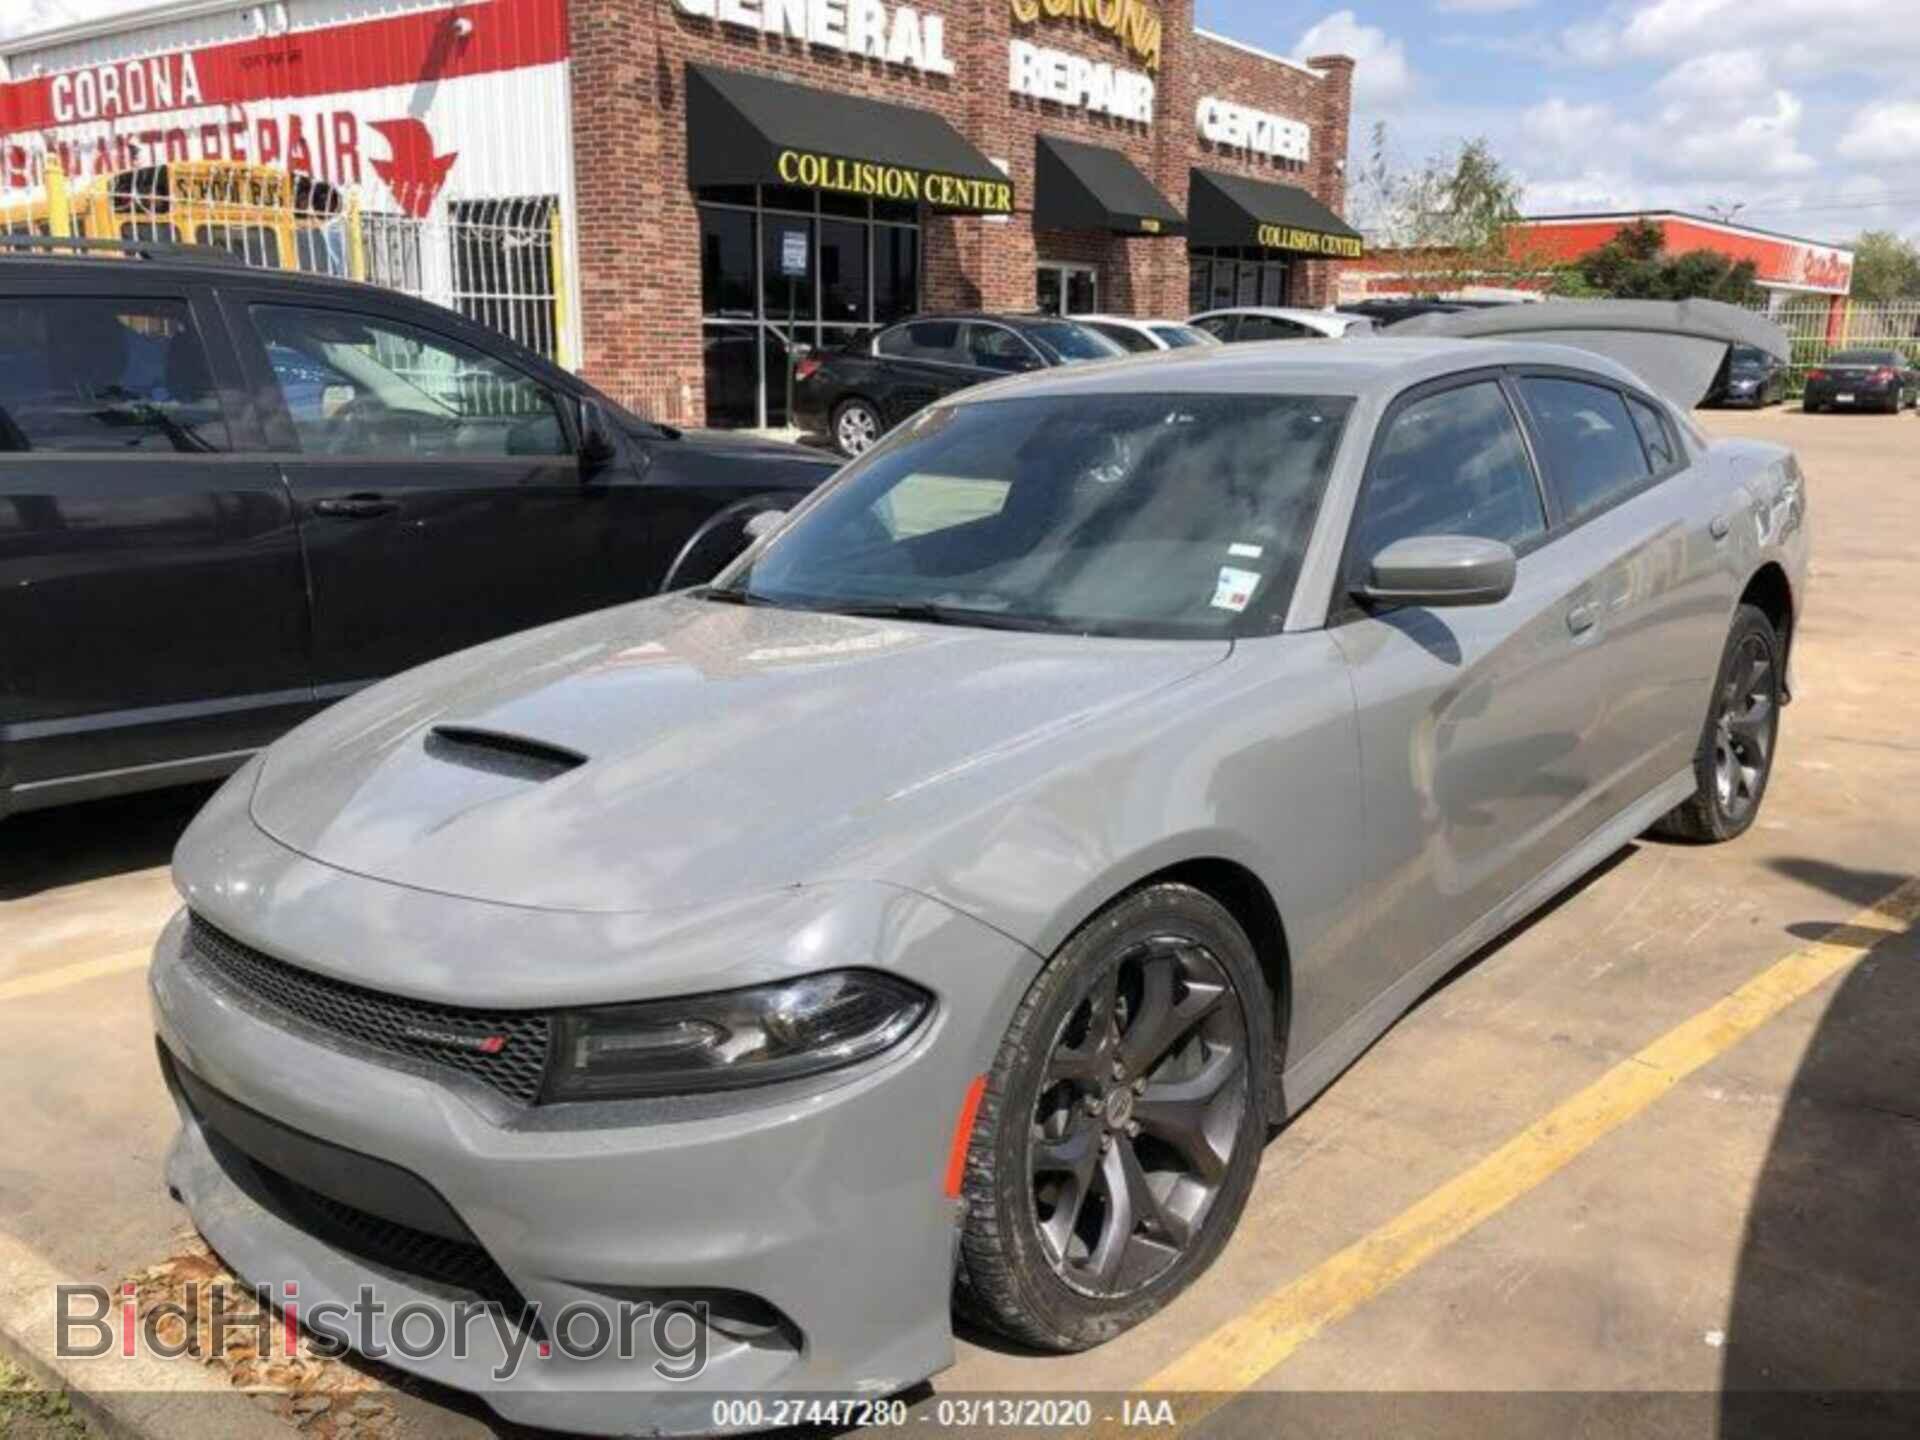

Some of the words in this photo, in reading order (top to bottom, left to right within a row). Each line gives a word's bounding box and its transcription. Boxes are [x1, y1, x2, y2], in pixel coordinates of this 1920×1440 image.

[50, 53, 203, 123] CORONA
[1008, 38, 1155, 124] REPAIR
[1195, 96, 1311, 163] CENTER
[778, 150, 920, 200] COLLISION
[924, 173, 1012, 212] CENTER
[1258, 224, 1320, 251] COLLISION
[1321, 233, 1361, 257] CENTER
